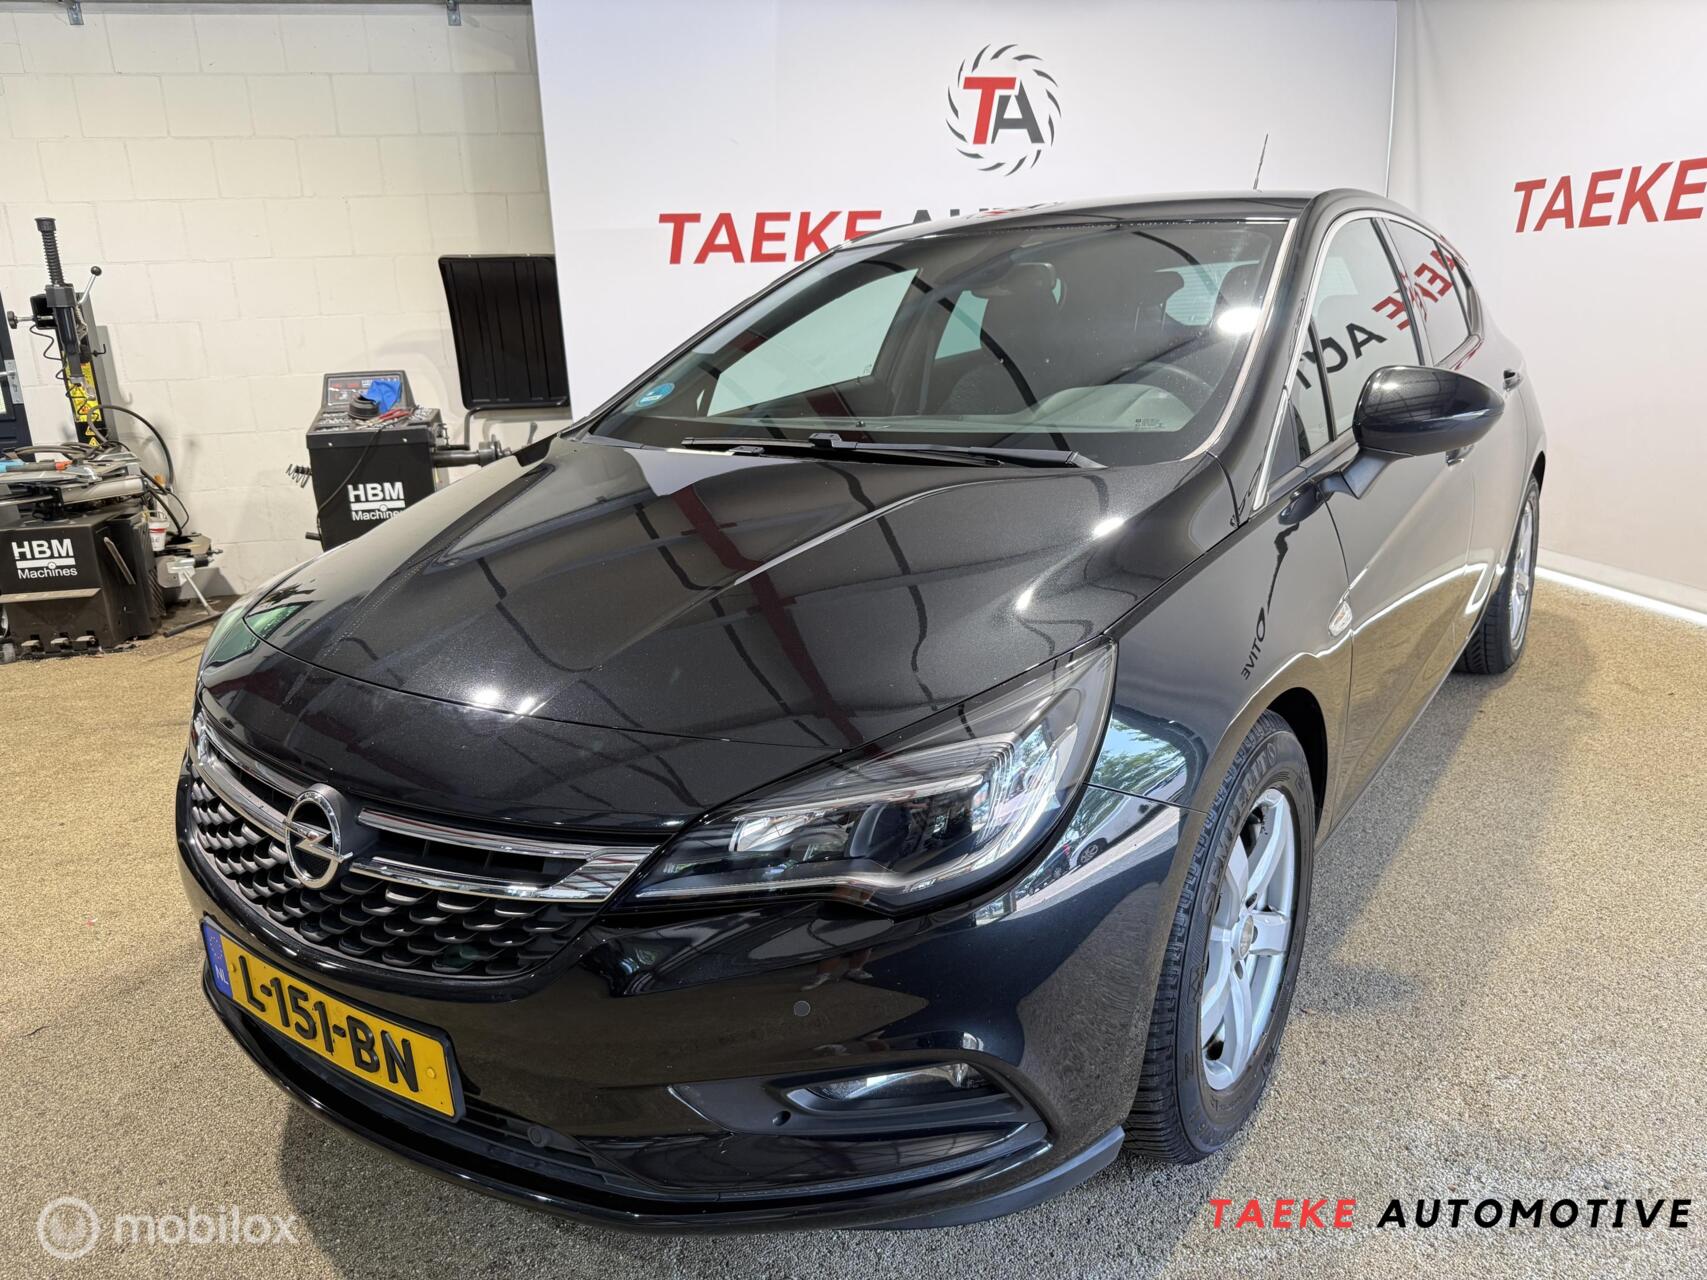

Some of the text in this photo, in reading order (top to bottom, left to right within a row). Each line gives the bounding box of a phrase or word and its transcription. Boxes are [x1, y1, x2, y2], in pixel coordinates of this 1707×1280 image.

[963, 76, 1045, 145] TA
[1514, 157, 1707, 233] TAEKE
[347, 481, 404, 502] HBM
[352, 510, 403, 521] Machine
[11, 538, 74, 560] HBM
[17, 566, 78, 580] Machines
[215, 965, 229, 985] NL
[239, 954, 419, 1093] L-151-BN
